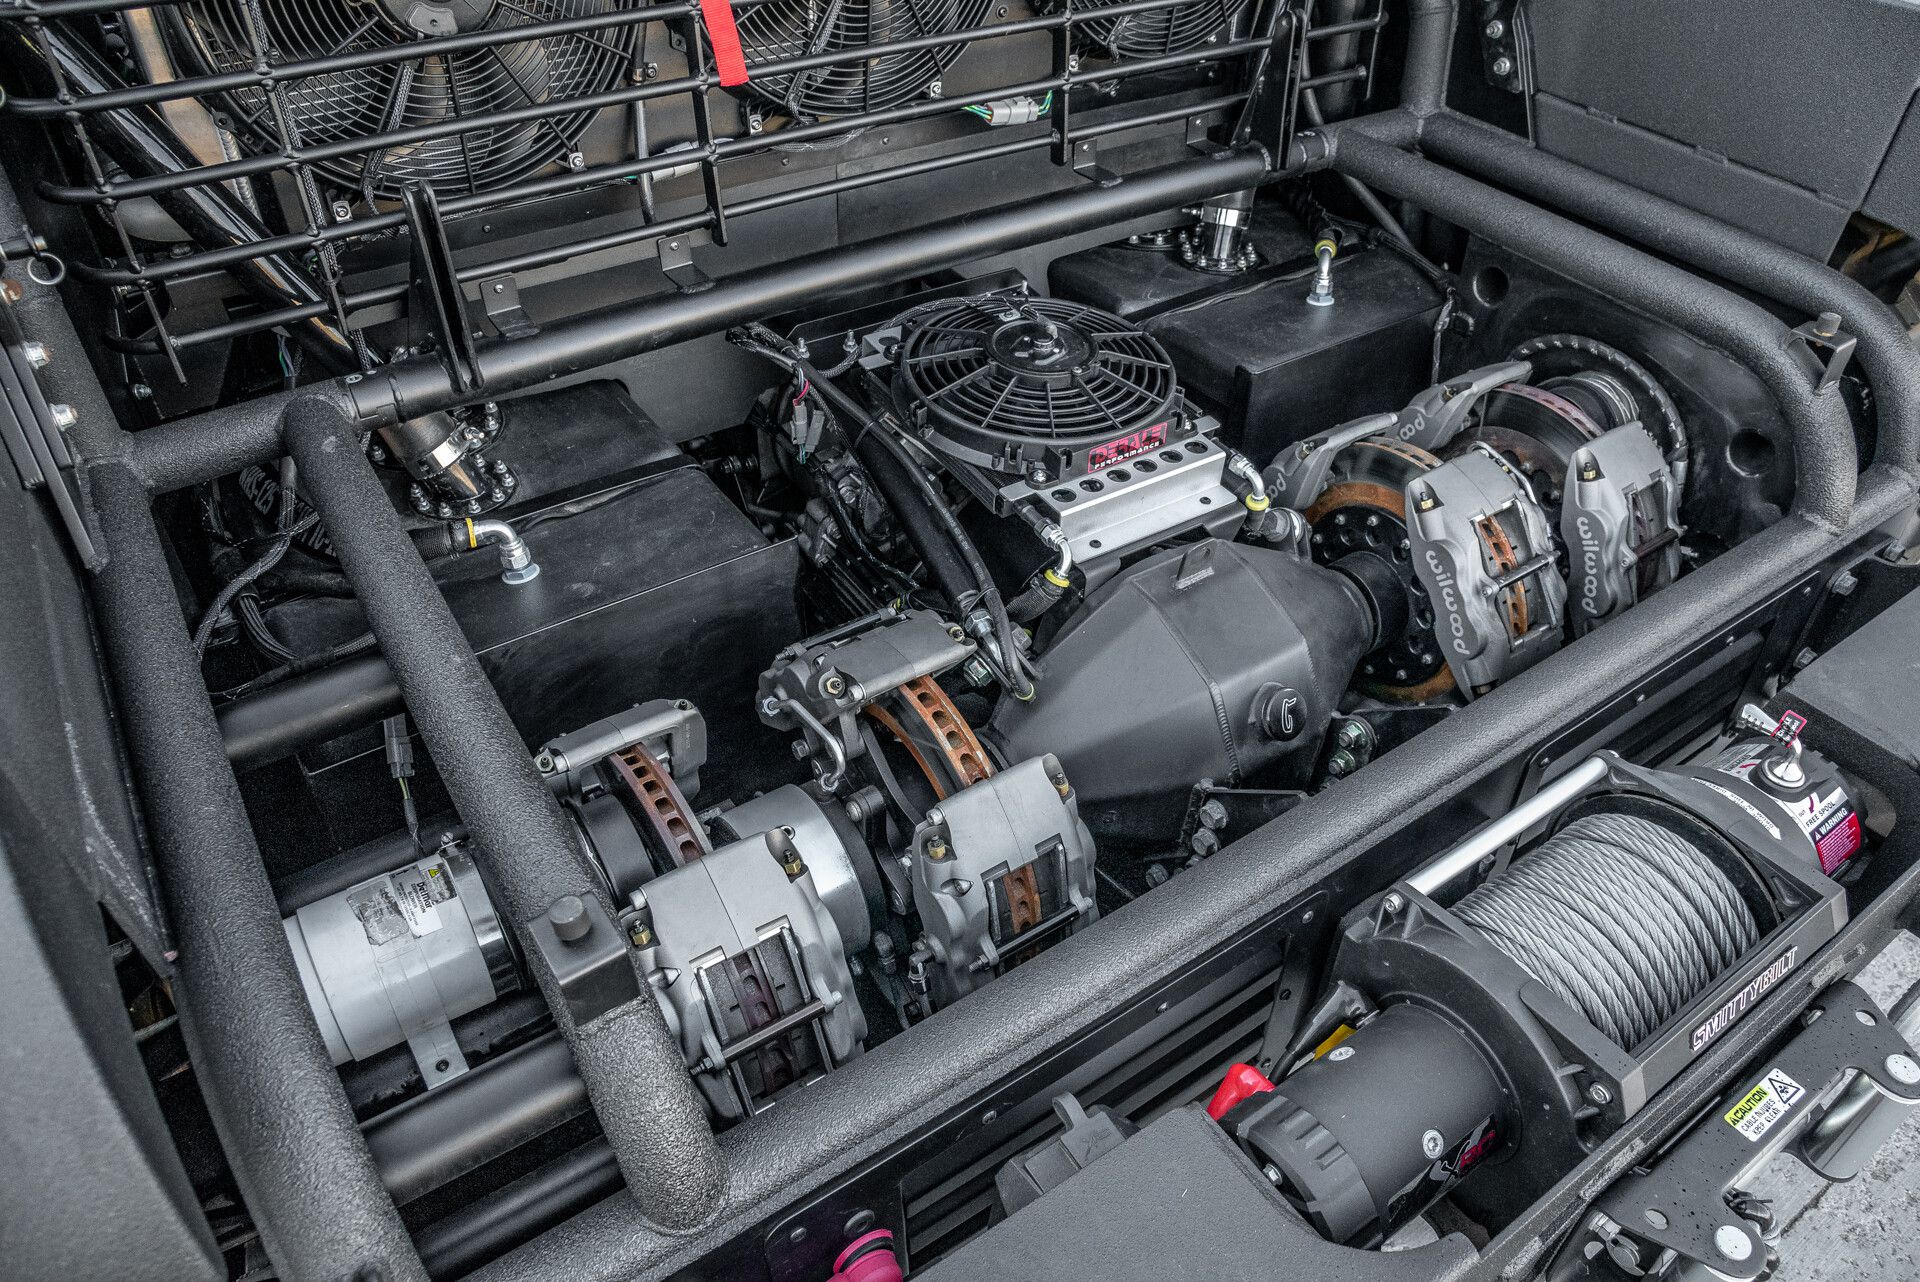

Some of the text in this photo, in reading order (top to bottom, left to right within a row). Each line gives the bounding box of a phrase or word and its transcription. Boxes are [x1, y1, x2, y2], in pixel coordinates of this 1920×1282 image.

[1094, 441, 1160, 470] PERFORMANCE
[1576, 516, 1600, 615] wilwood
[1425, 550, 1470, 655] wilwood
[1805, 801, 1836, 828] FREE SPOOL
[1819, 807, 1848, 834] WARNING
[1692, 945, 1798, 1051] SMITTYBILT
[1733, 1087, 1768, 1121] CAUTION
[1740, 1113, 1759, 1132] CABLE
[1752, 1106, 1782, 1135] KEEP CLEAR
